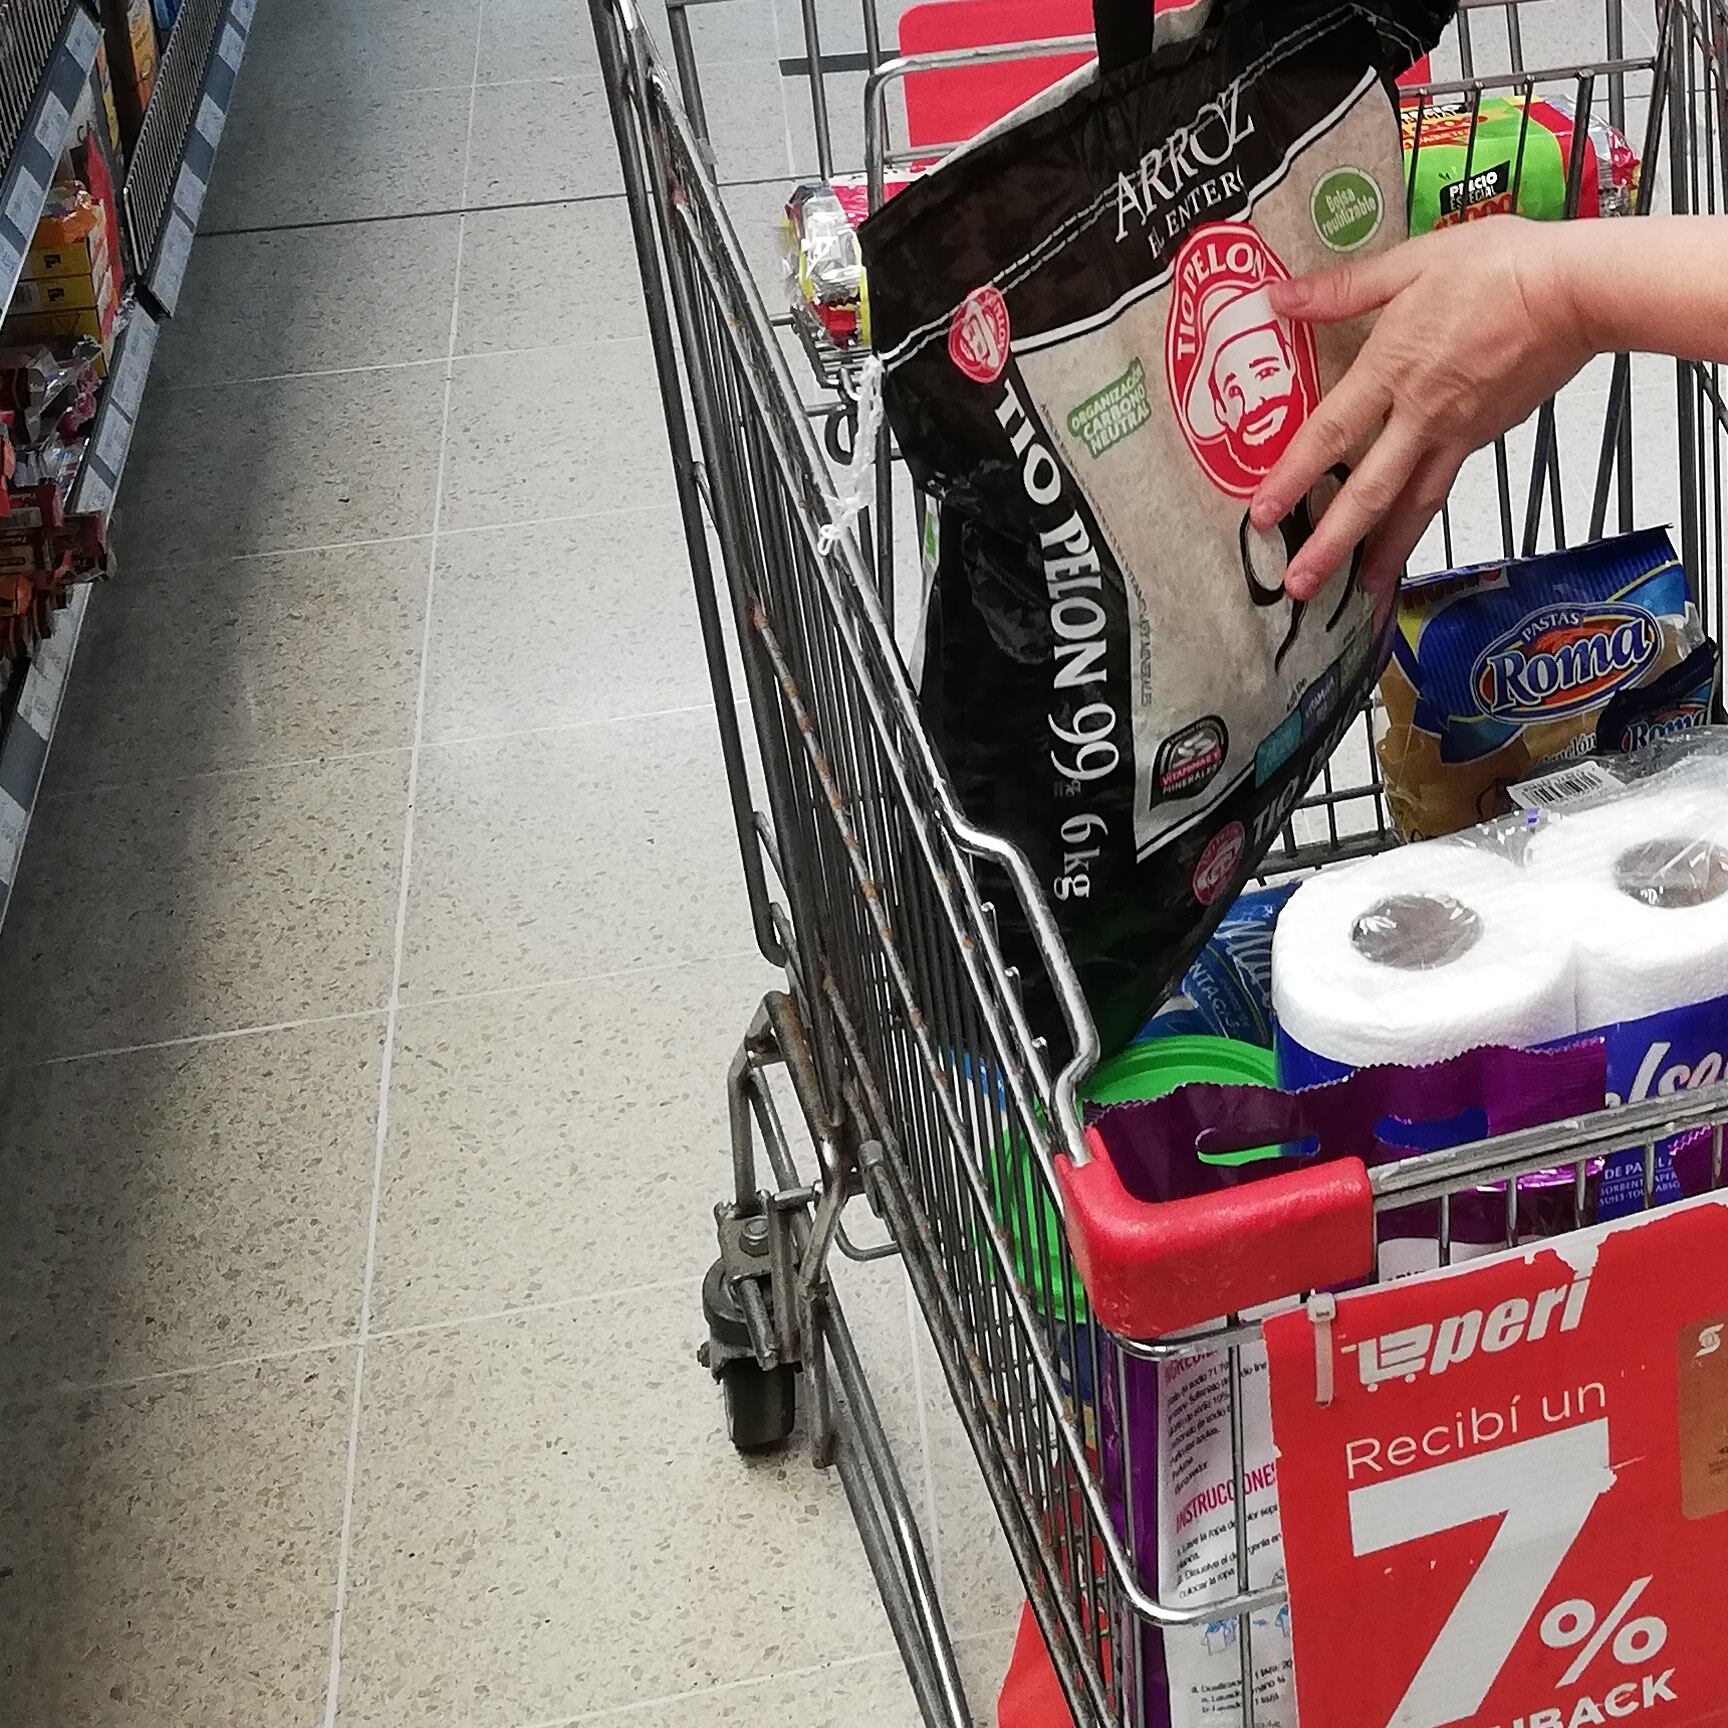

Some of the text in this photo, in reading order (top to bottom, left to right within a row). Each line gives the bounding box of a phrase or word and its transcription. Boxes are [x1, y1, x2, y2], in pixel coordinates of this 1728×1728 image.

[1113, 74, 1256, 243] ARROZ
[1322, 195, 1377, 237] reutilizable
[1325, 188, 1355, 213] Bolsa
[994, 383, 1061, 506] TIO
[1084, 383, 1145, 440] CARBONO
[1090, 401, 1150, 455] NEUTRAL
[1039, 511, 1110, 691] PELON
[1521, 611, 1580, 644] PASTAS
[1486, 618, 1648, 713] Roma
[1046, 701, 1120, 782] 99
[1345, 1382, 1606, 1480] Recibí un
